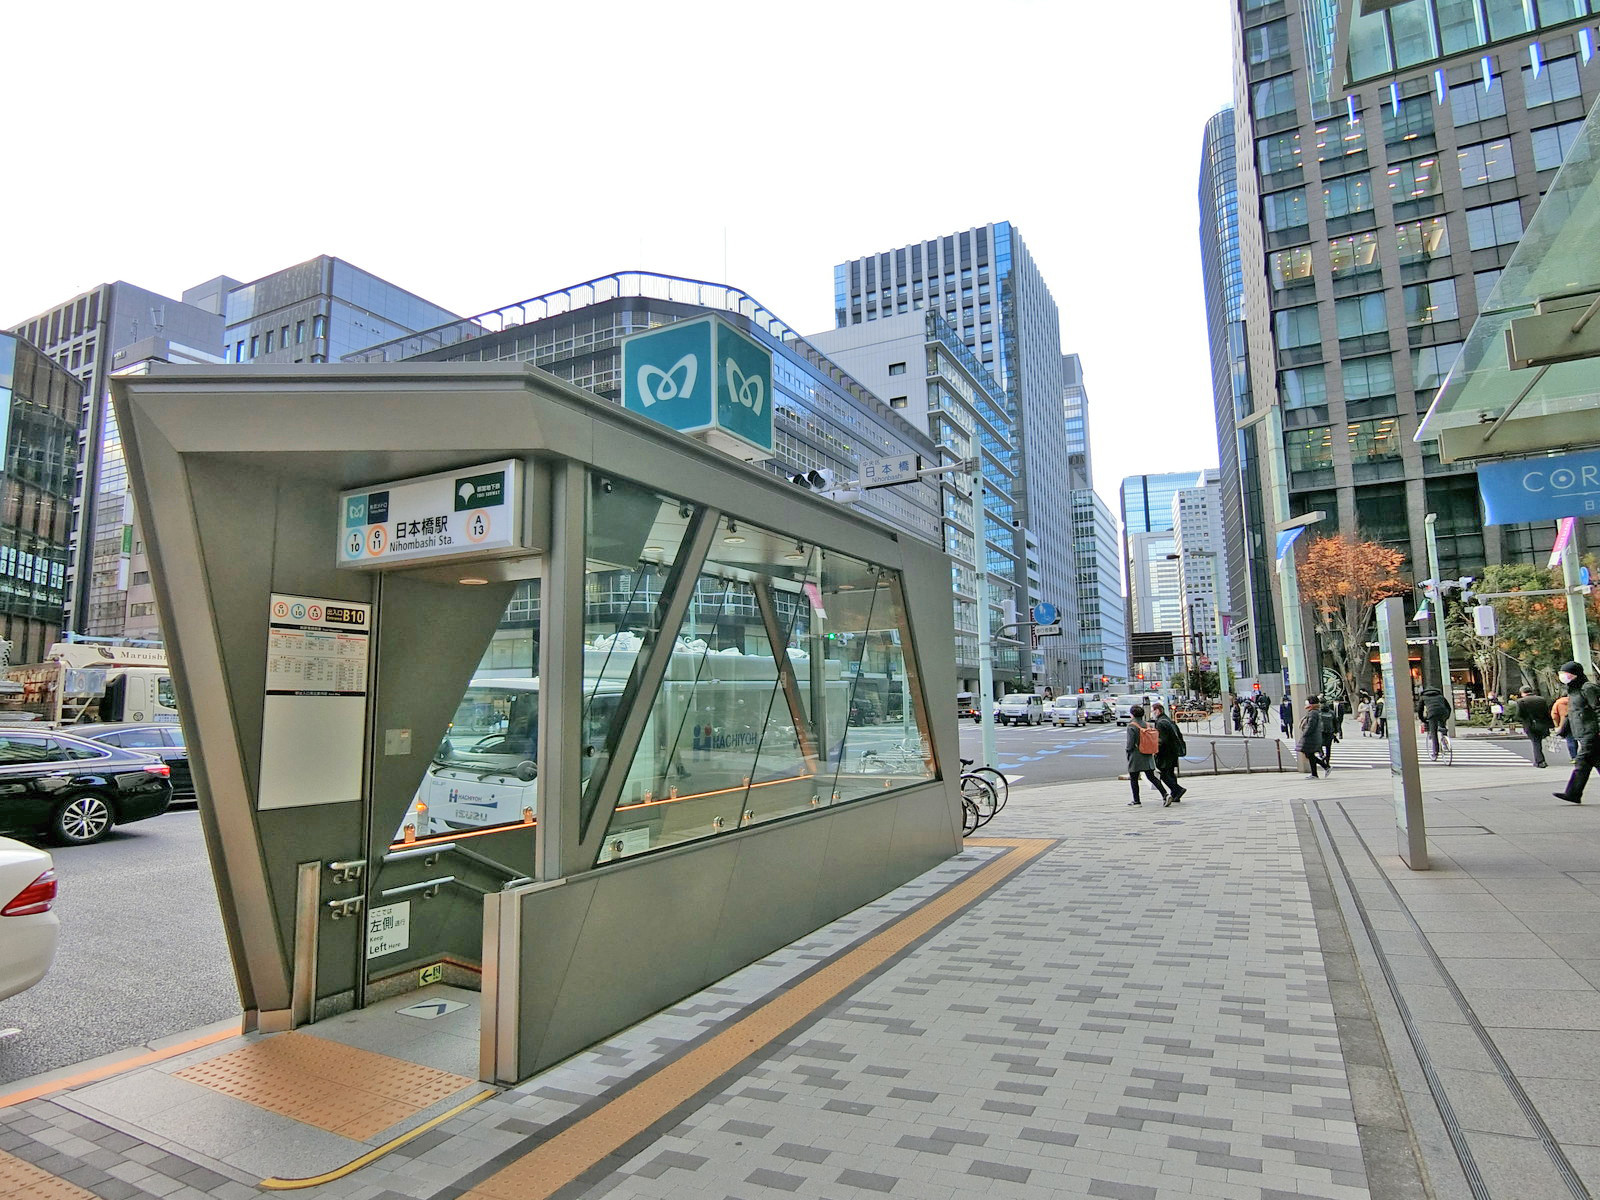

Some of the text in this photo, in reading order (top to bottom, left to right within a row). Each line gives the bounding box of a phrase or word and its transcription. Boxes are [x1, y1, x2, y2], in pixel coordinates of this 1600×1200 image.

[865, 460, 910, 478] 日本橋
[475, 515, 482, 525] A
[396, 515, 448, 540] 日本橋駅
[473, 525, 484, 536] 13
[353, 533, 358, 542] T
[374, 530, 380, 539] G
[351, 543, 360, 552] 10
[373, 540, 381, 550] 11
[389, 535, 454, 552] Nihombashi Sta.
[326, 608, 343, 617] 出入口
[343, 609, 364, 624] B10
[712, 731, 758, 749] HACHIYOH
[370, 908, 393, 918] ここでは
[369, 935, 384, 943] Keep
[369, 942, 401, 955] Left Here
